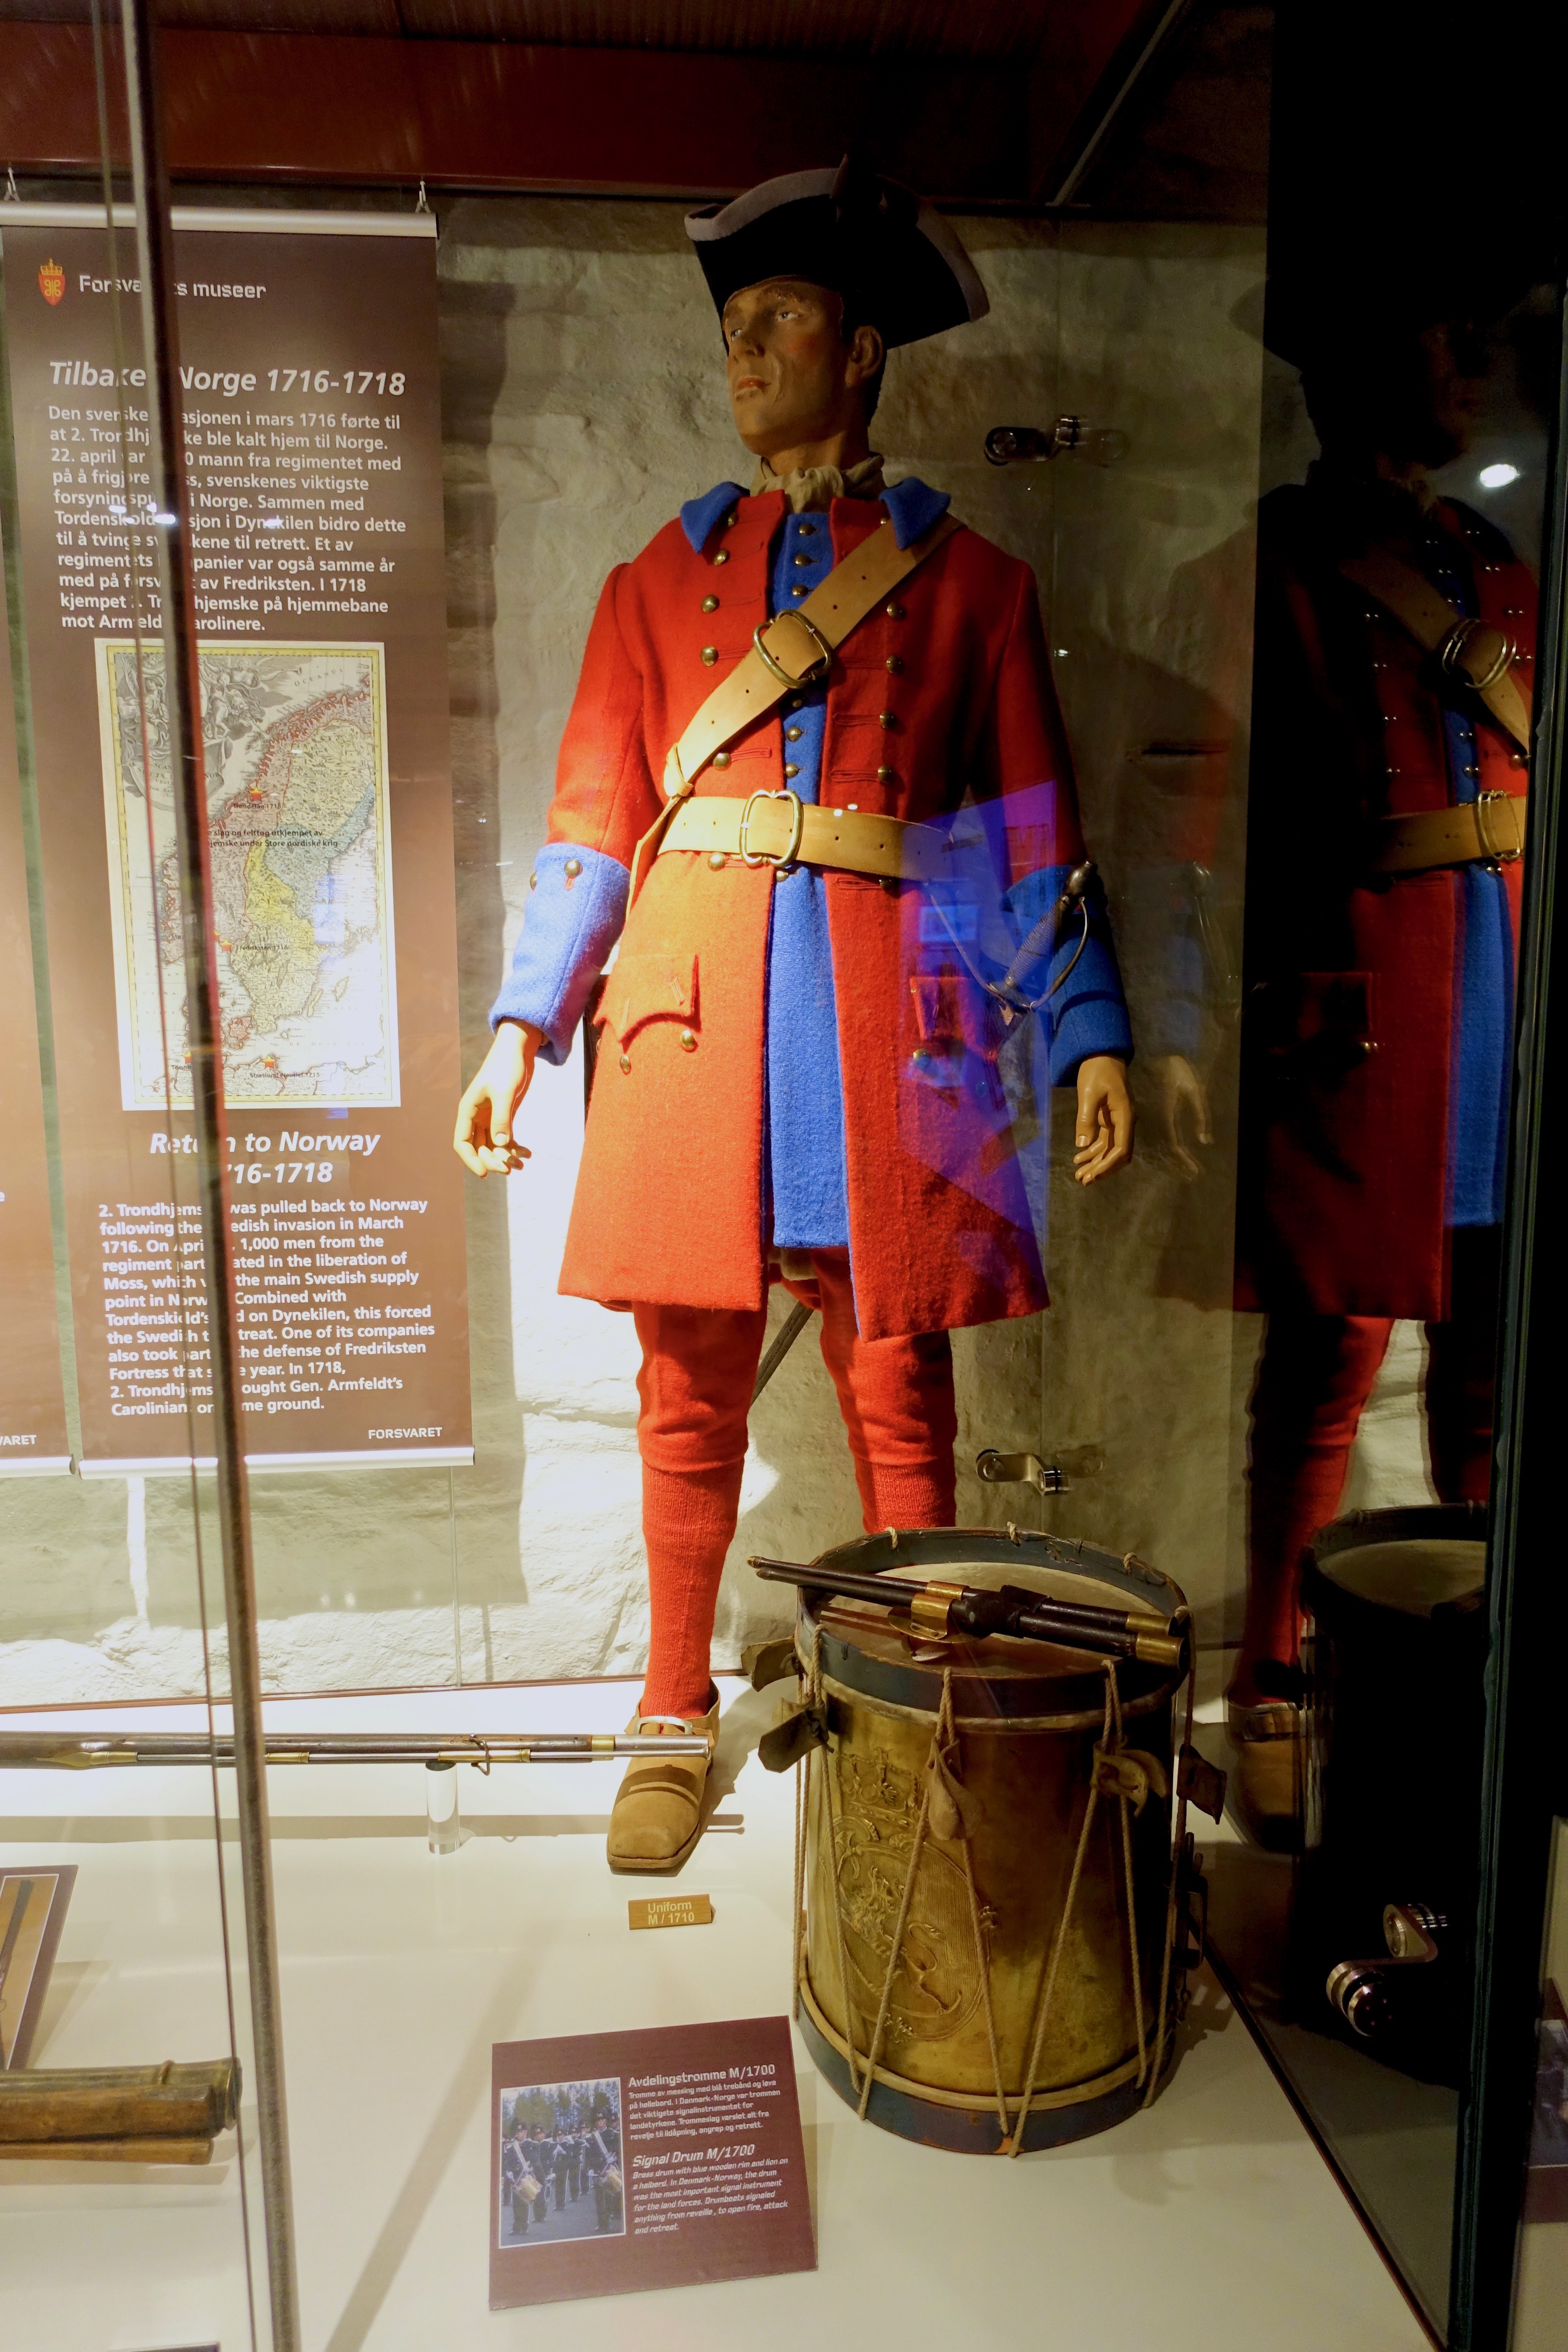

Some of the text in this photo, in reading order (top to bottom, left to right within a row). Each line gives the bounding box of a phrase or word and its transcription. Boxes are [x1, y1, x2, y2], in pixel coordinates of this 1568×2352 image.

[193, 282, 266, 298] museer
[268, 369, 405, 395] 1716-1718
[49, 406, 400, 429] Den mars 1716 førte til
[50, 429, 387, 452] at ble kalt hjem til Norge.
[52, 448, 401, 471] 22. april mann fra regimentet med
[53, 469, 368, 493] på svenskenes viktigste
[200, 493, 364, 511] Norge. Sammen med
[319, 516, 406, 532] bidro dette
[56, 531, 353, 551] til til retrett. Et av
[248, 556, 395, 573] var også samme år
[60, 573, 366, 592] med på av Fredriksten. 1718
[61, 592, 388, 614] kjempet på hjemmebane
[62, 616, 95, 628] mot
[245, 1132, 380, 1156] to Norway
[99, 1199, 428, 1217] 2. pulled back Norway
[100, 1216, 403, 1237] following invasion March
[102, 1234, 384, 1253] 1716. On 1,000 men from the
[103, 1253, 386, 1274] regiment the liberation
[104, 1270, 419, 1290] Moss, the main Swedish supply
[105, 1289, 346, 1311] point Combined with
[273, 1305, 431, 1324] Dynekilen, this forced
[107, 1323, 435, 1344] the One its companies
[108, 1341, 426, 1362] also took defense Fredriksten
[110, 1361, 346, 1380] Fortress year. In 1718,
[290, 1377, 403, 1392] Gen. Armfeldt’s
[267, 1397, 324, 1413] ground.
[369, 1427, 442, 1439] FORSVARET
[648, 1902, 692, 1913] Uniform
[649, 1915, 657, 1924] M
[669, 1912, 694, 1923] 1710
[729, 2064, 775, 2079] M/1700
[724, 2081, 751, 2090] trebånd
[630, 2102, 637, 2110] på
[643, 2110, 674, 2118] viktigste
[722, 2112, 745, 2120] varslet
[735, 2121, 763, 2130] retrett.
[633, 2144, 755, 2168] Signal Drum M/1700
[710, 2162, 736, 2171] wooden
[639, 2180, 668, 2189] halberd.
[683, 2185, 720, 2196] important
[721, 2183, 741, 2193] signal
[705, 2194, 744, 2204] Drumbeats
[634, 2214, 665, 2223] anything
